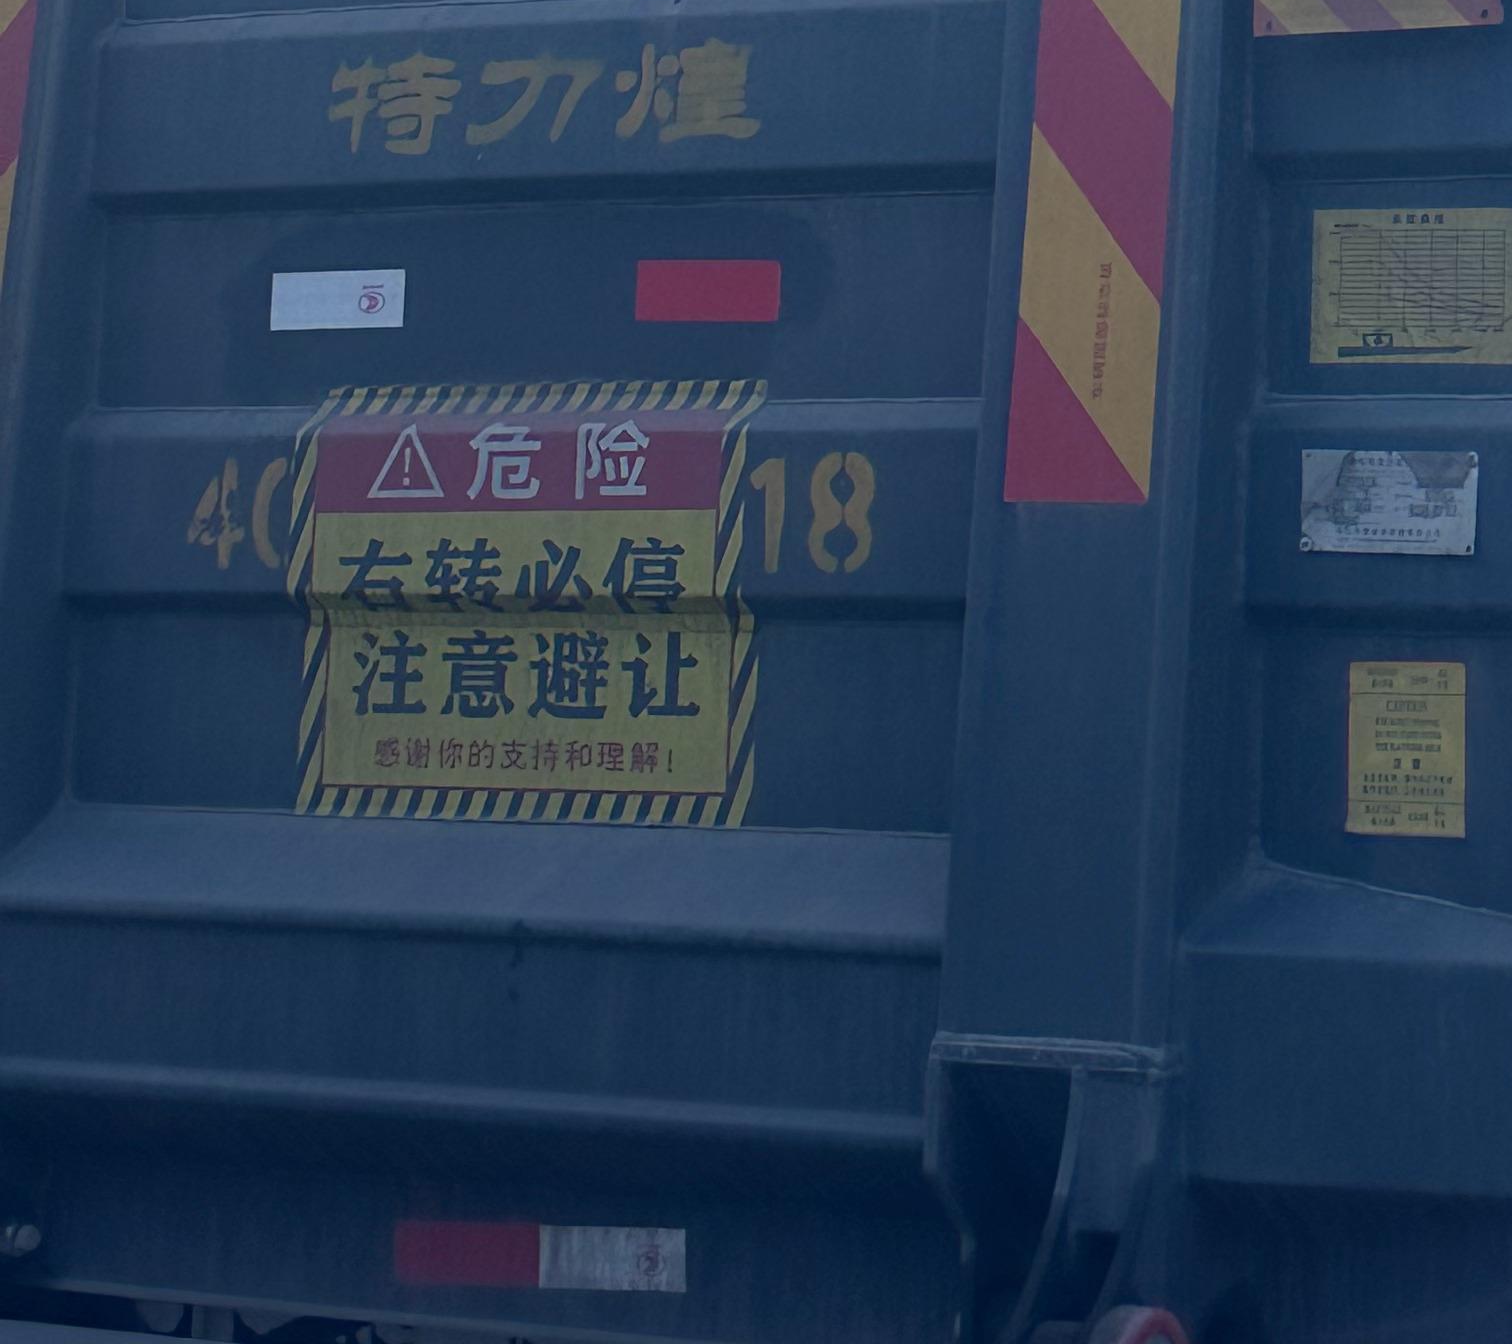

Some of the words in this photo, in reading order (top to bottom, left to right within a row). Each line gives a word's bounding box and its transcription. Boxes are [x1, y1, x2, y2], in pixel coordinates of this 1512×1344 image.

[465, 419, 651, 502] 危险
[338, 536, 687, 614] 右转必停
[351, 629, 700, 720] 注意避让
